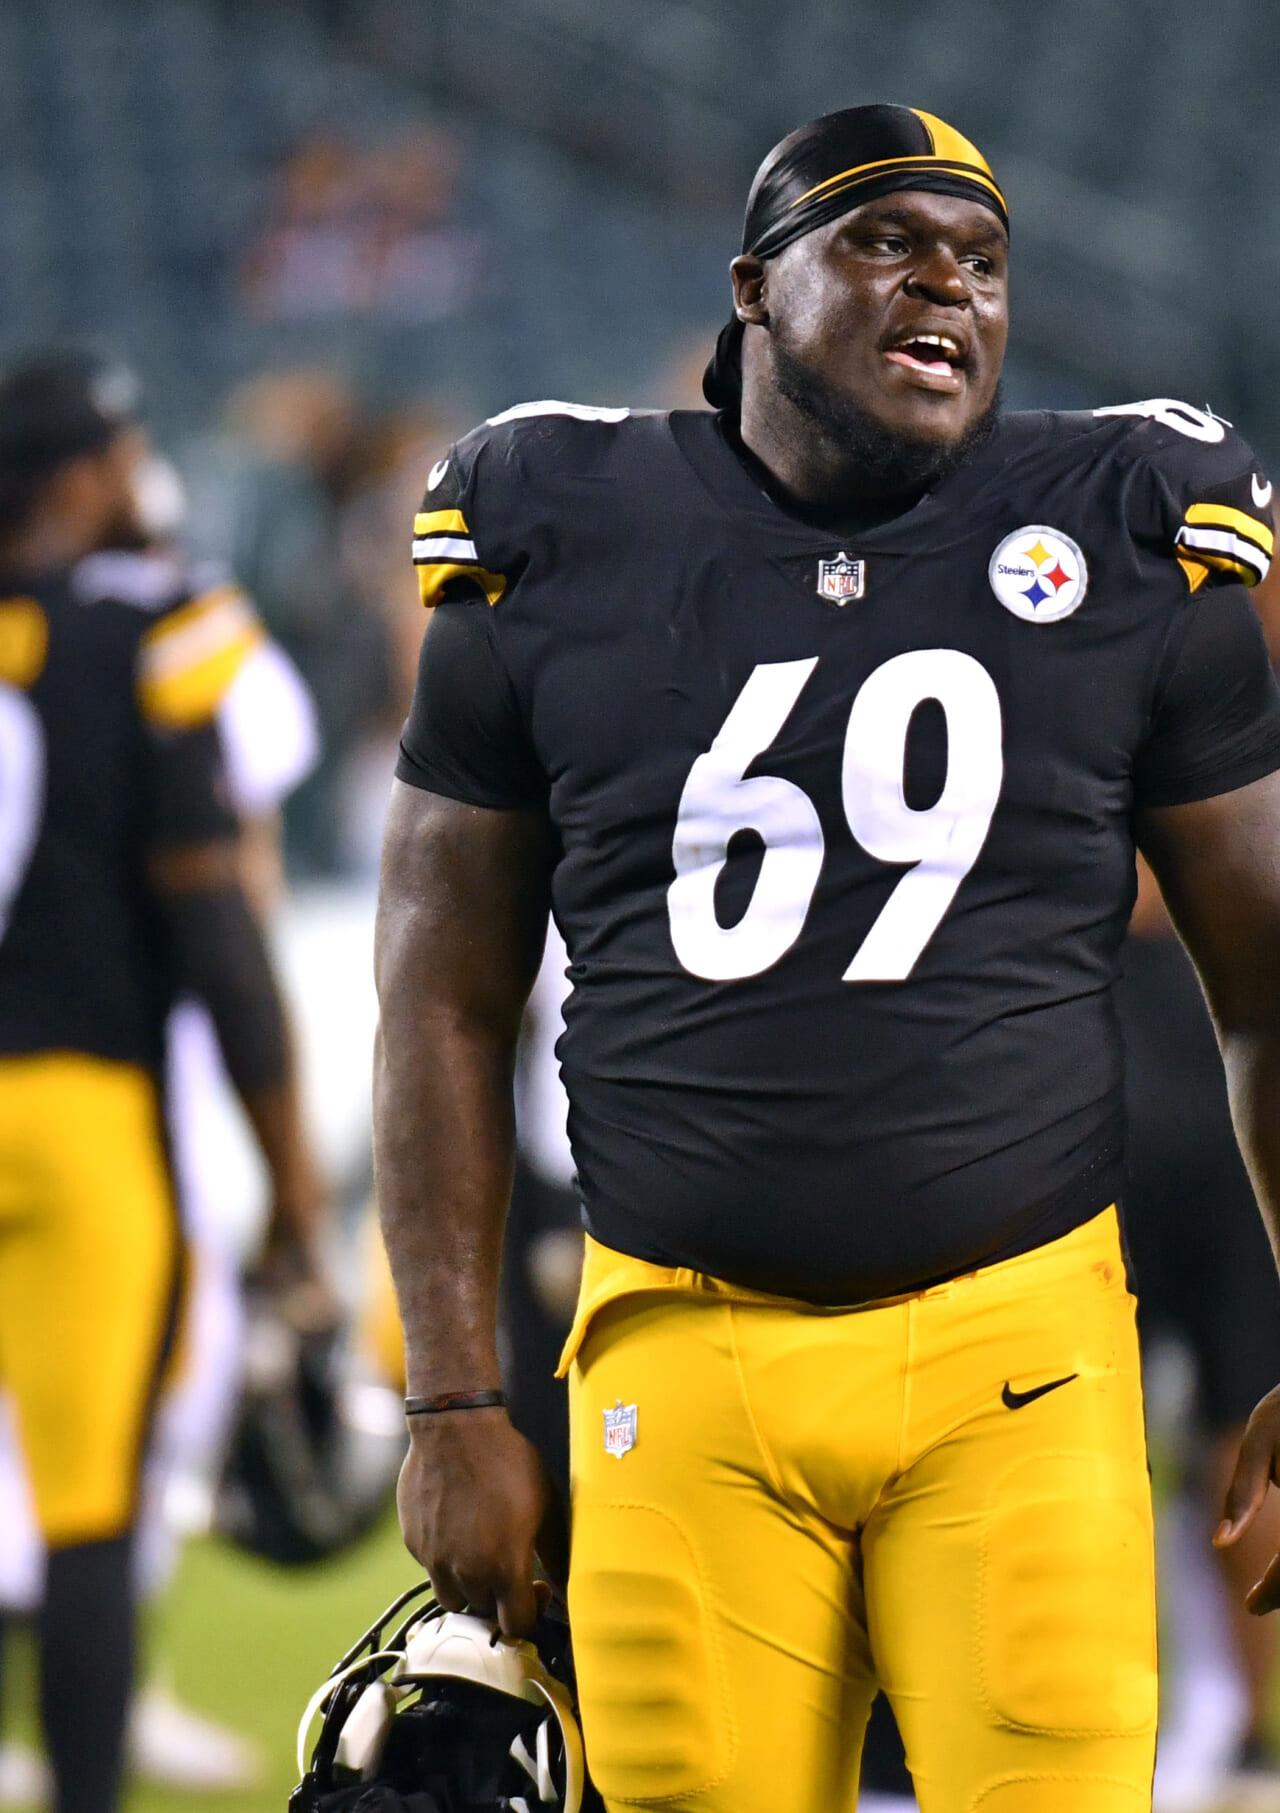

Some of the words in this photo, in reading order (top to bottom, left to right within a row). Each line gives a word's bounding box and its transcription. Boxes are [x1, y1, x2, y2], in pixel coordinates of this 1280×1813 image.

[997, 562, 1036, 578] Steelers
[827, 575, 856, 594] NFL
[667, 648, 1003, 981] 69
[608, 1425, 631, 1447] NFL
